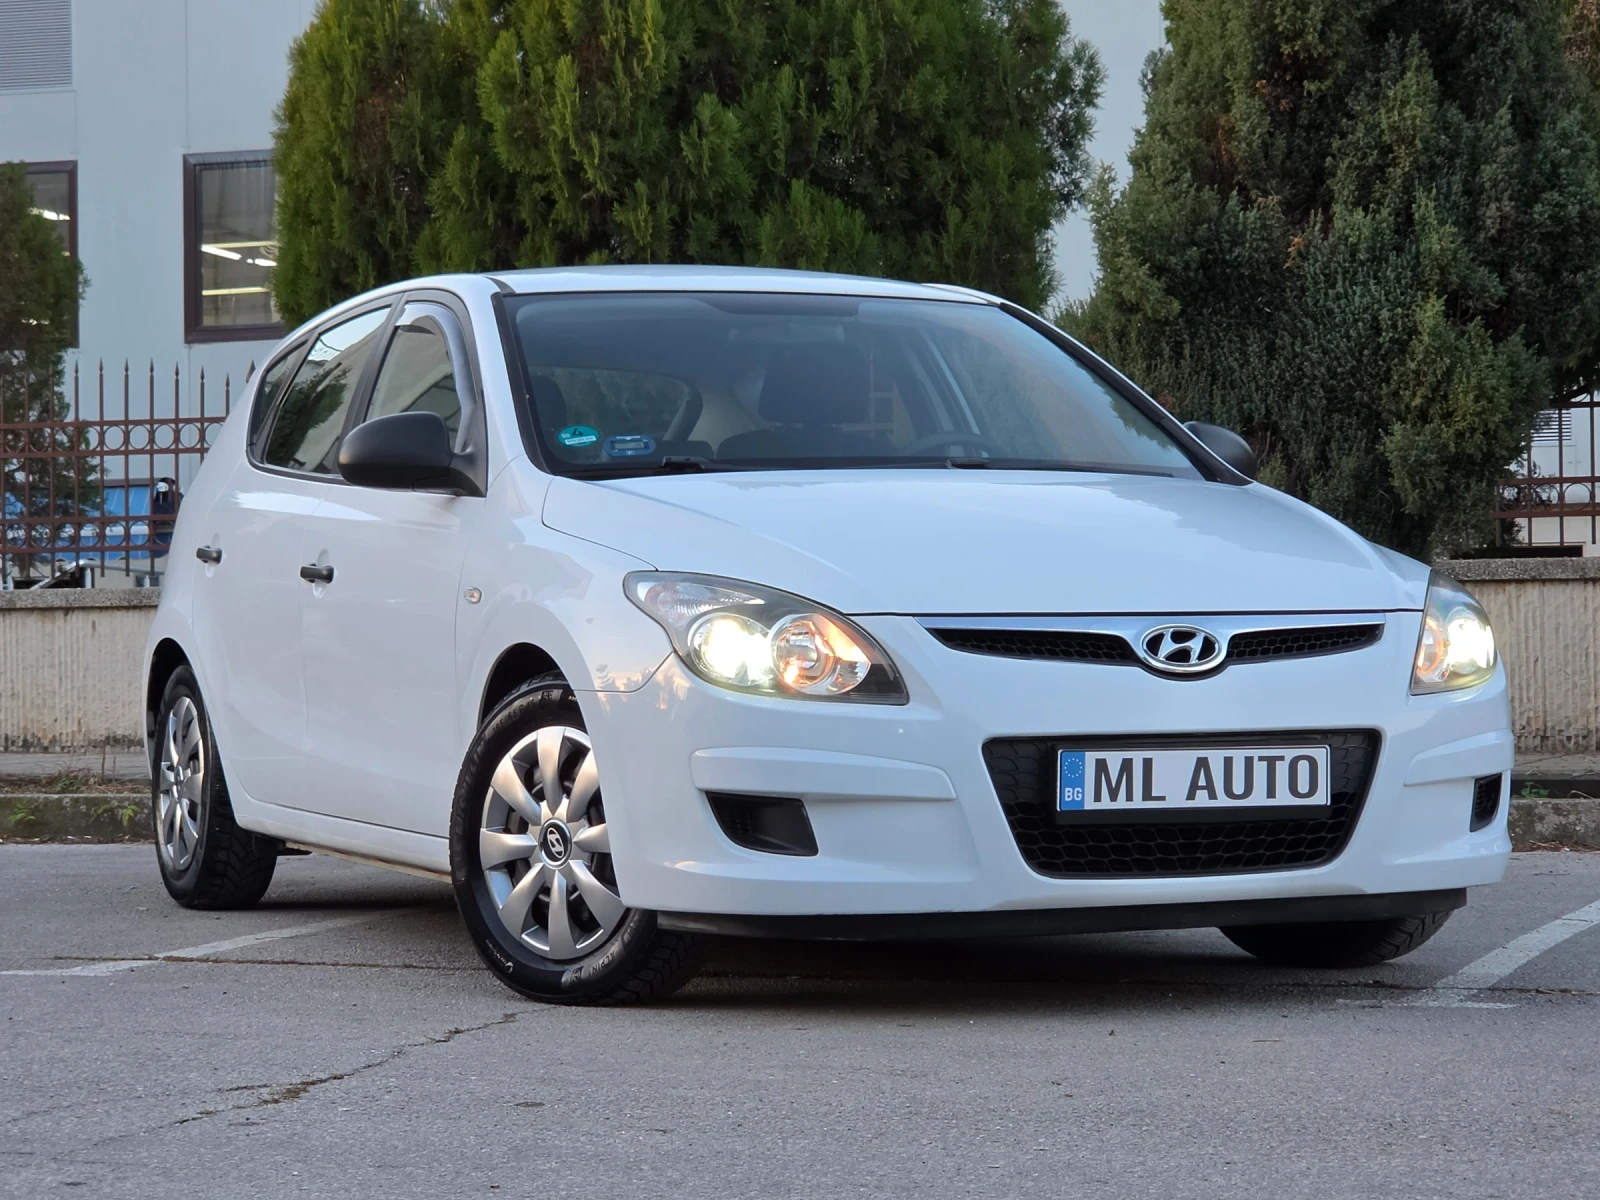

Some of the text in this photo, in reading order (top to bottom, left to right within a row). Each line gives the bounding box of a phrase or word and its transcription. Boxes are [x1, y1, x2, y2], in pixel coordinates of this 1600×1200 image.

[1064, 787, 1083, 801] BG
[1093, 754, 1319, 803] ML AUTO
